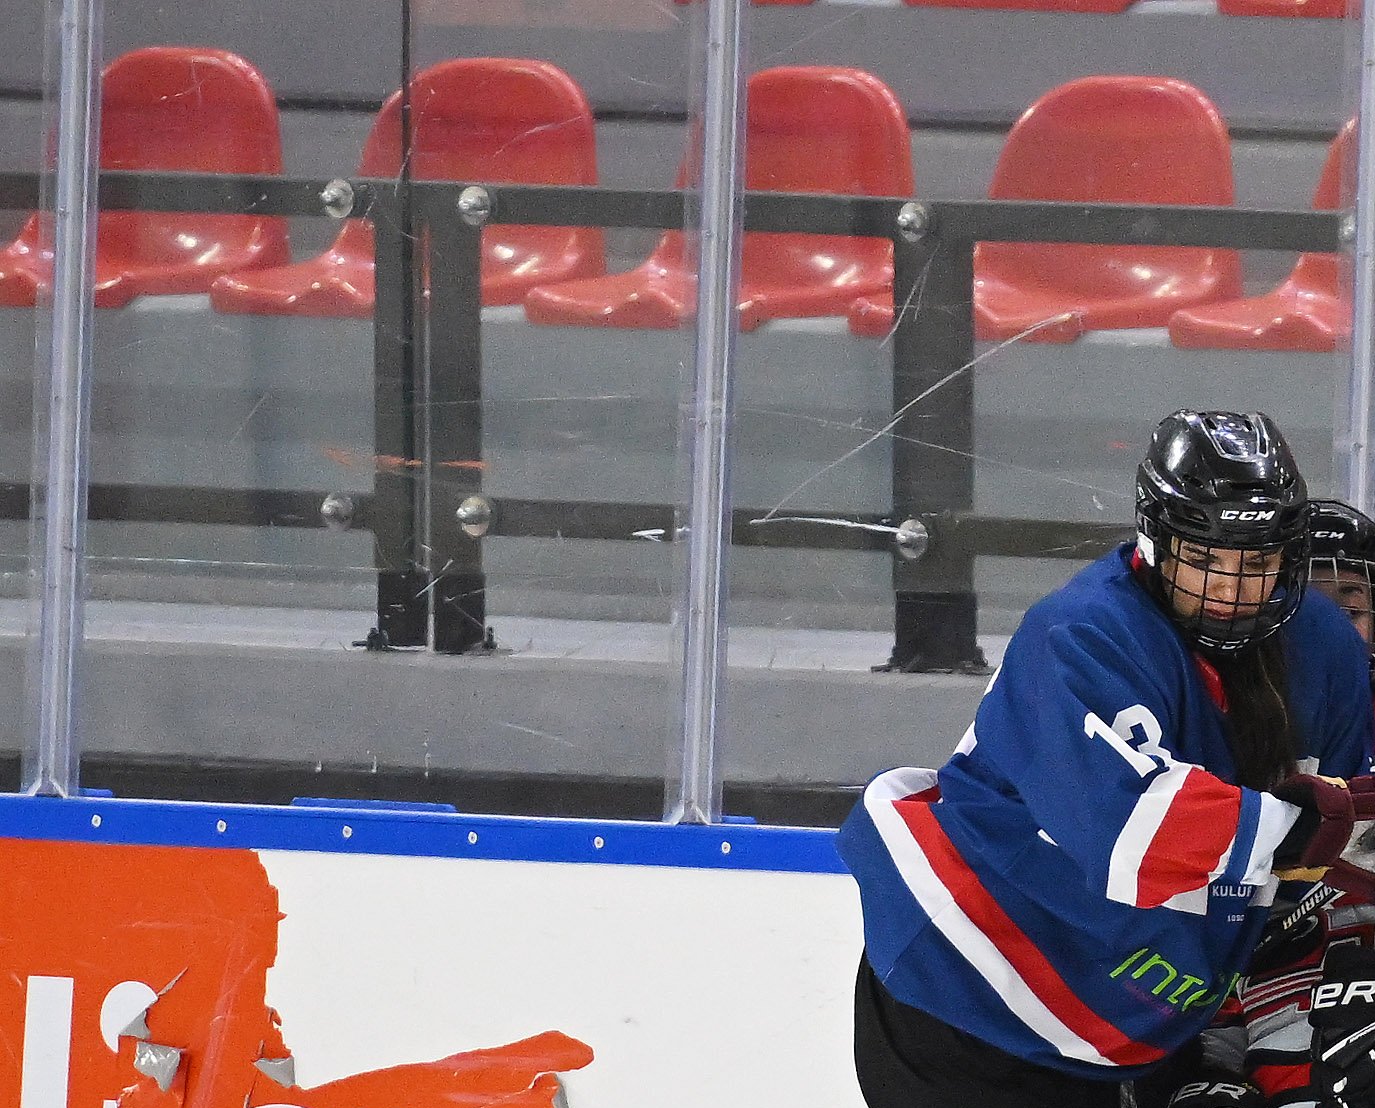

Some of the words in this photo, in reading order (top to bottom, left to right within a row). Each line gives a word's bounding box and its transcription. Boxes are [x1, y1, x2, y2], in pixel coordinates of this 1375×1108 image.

[1221, 509, 1276, 521] CCM
[1312, 531, 1345, 539] CM
[1282, 885, 1334, 931] ARRIOR
